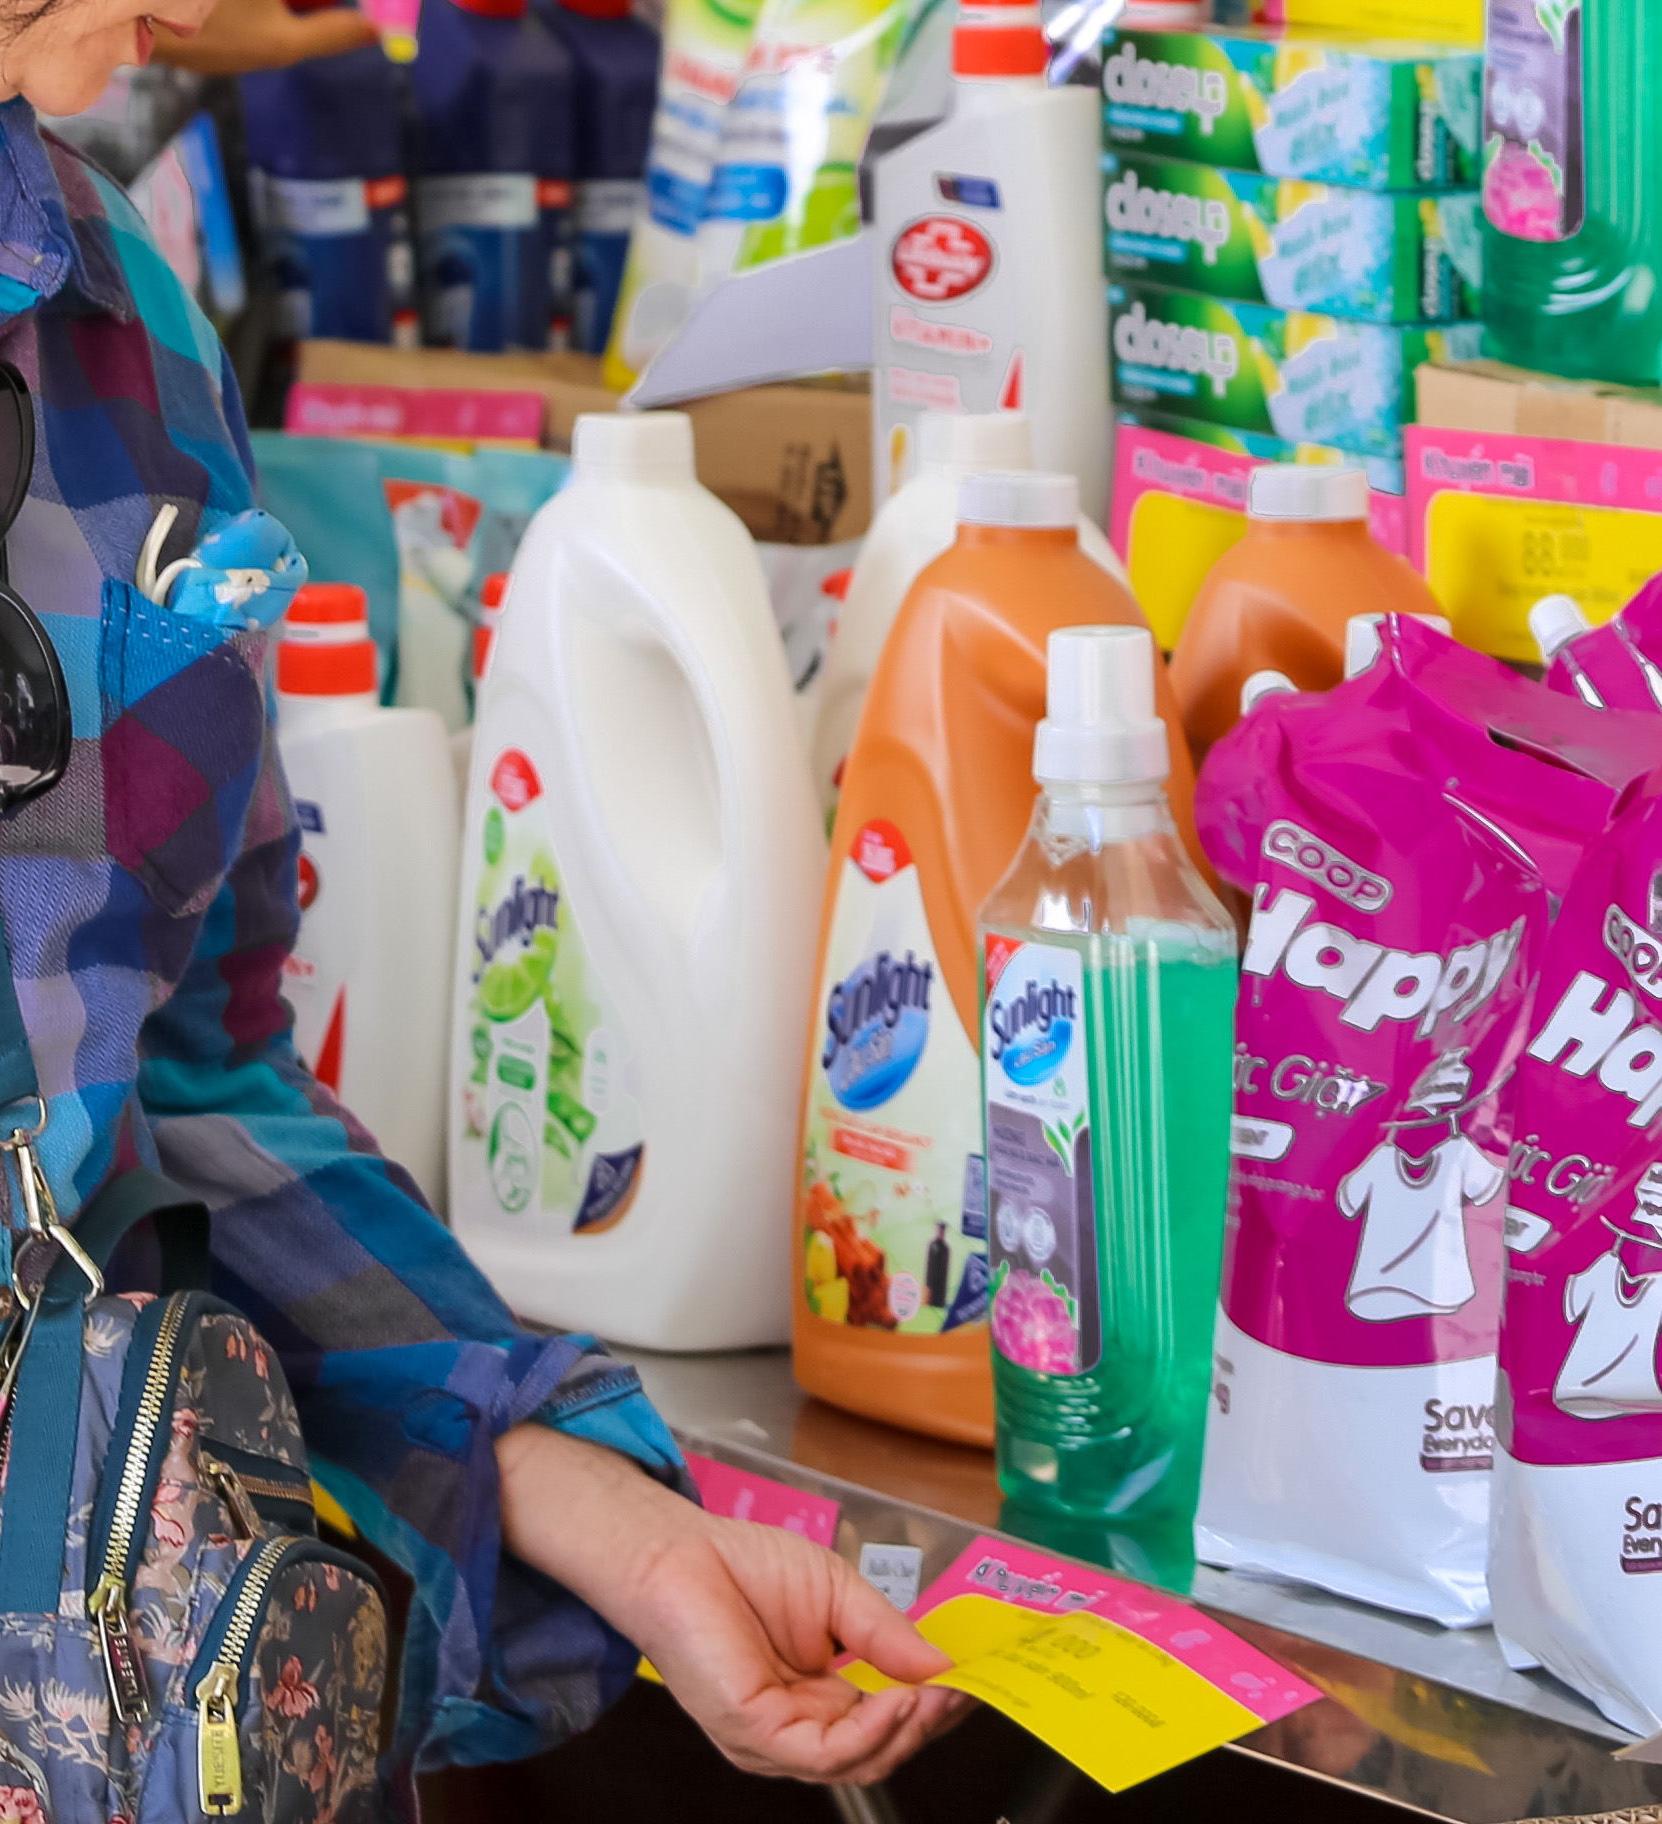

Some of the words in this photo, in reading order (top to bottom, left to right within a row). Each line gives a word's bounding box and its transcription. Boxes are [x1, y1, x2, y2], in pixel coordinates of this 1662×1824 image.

[1268, 826, 1385, 903] COOP
[822, 949, 935, 1070] Sunlight
[991, 977, 1077, 1061] Sunlight
